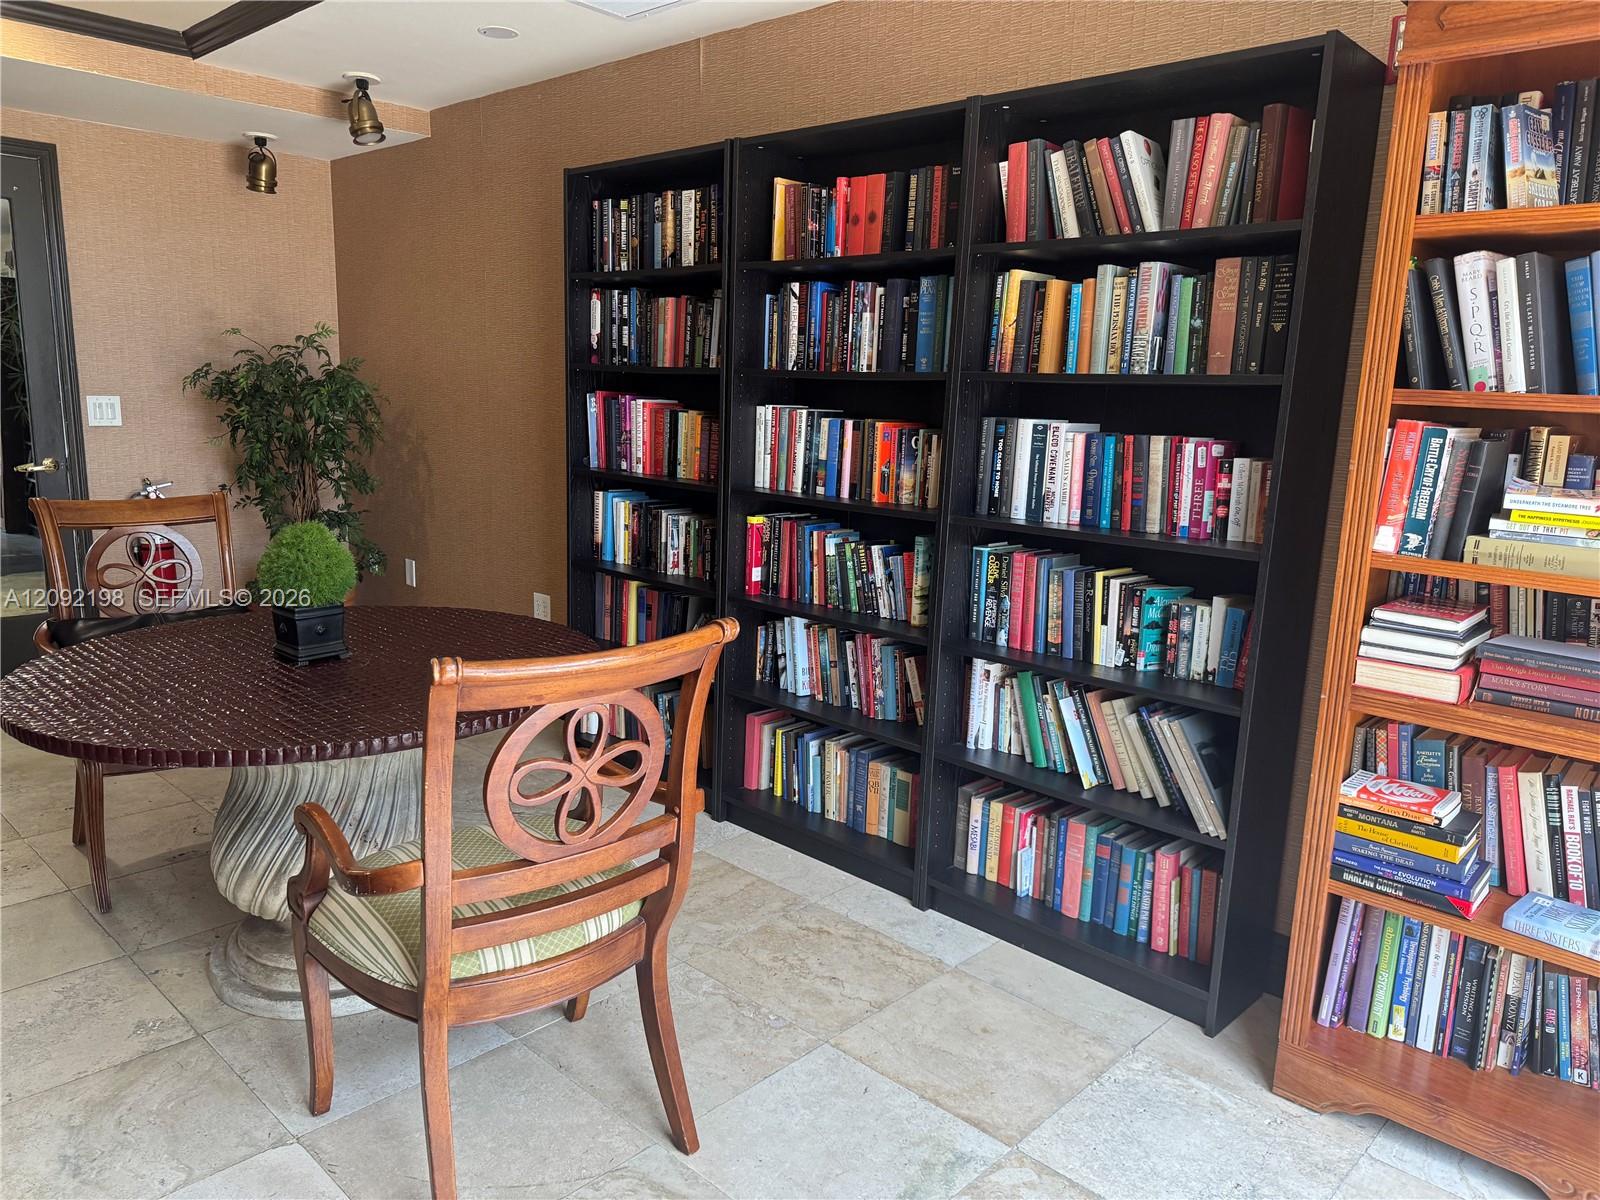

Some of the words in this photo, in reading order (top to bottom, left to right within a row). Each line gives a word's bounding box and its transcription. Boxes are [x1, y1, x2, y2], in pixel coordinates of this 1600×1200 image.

[1455, 112, 1465, 133] CLIVE
[1452, 134, 1464, 169] CUSSLER'S
[1472, 138, 1483, 163] CORNWELL
[1526, 131, 1554, 153] CUSSLER
[1192, 151, 1202, 170] ALSO
[1574, 145, 1583, 166] AWAY
[1190, 172, 1199, 186] SETS
[1452, 187, 1460, 204] DEVIL'S
[1260, 260, 1269, 276] Pink
[1140, 266, 1153, 296] PATRICIA
[1258, 276, 1267, 292] Slip
[1128, 294, 1136, 307] OUR
[1433, 294, 1443, 308] Men
[790, 301, 799, 332] TRIPLE
[1126, 308, 1134, 333] HEALTH
[1136, 297, 1150, 329] CORNWELL
[1110, 311, 1119, 341] PERSIAN
[1436, 313, 1449, 335] Women
[1109, 342, 1118, 356] BOY
[1123, 333, 1131, 360] MATTERS
[1131, 333, 1149, 362] TRACE
[1427, 437, 1443, 463] BATTLE
[995, 471, 1001, 480] TO
[1048, 449, 1058, 484] COVENANT
[1424, 463, 1438, 477] CRY
[1423, 477, 1434, 487] OF
[1192, 479, 1204, 520] THREE
[1415, 487, 1433, 520] FREEDOM
[1505, 522, 1516, 530] GET
[1559, 527, 1569, 535] PIT
[1552, 516, 1580, 524] HYPOTHESIS
[987, 555, 995, 584] CUSSLER
[1001, 556, 1009, 579] Daniel
[1000, 580, 1008, 598] Silva
[984, 599, 993, 628] REVENGE
[1505, 664, 1527, 675] Weigh
[1528, 668, 1549, 678] Down
[1551, 673, 1566, 681] Diet
[1536, 660, 1557, 668] LEOPARD
[1491, 676, 1520, 687] MARK'S
[1521, 681, 1550, 692] STORY
[868, 780, 880, 788] QB
[1546, 787, 1560, 809] GEMINI
[1566, 788, 1575, 813] RACHAEL
[1582, 800, 1590, 815] EIGHT
[1343, 807, 1359, 815] NORTH
[1358, 813, 1398, 828] MONTANA
[1400, 811, 1421, 821] DIARY
[1357, 824, 1369, 832] The
[1369, 827, 1389, 837] House
[1568, 814, 1576, 830] RAY'S
[1584, 816, 1592, 834] WORDS
[969, 824, 978, 850] MESABI
[1565, 834, 1581, 860] BOOK
[1351, 846, 1378, 857] WAKING
[1396, 857, 1415, 867] DEAD
[1567, 860, 1582, 876] OF
[1133, 879, 1139, 889] AT
[1342, 872, 1374, 889] HARLAN
[1394, 875, 1431, 889] DISCOVERIES
[1397, 871, 1437, 887] EVOLUTION
[1568, 878, 1583, 890] 10
[1129, 889, 1138, 920] WILDINGS
[1420, 934, 1428, 945] AND
[1513, 919, 1540, 939] THREE
[1543, 929, 1580, 952] SISTERS
[1376, 926, 1394, 971] abnormal
[1405, 940, 1418, 975] Developmental
[1415, 957, 1425, 979] ENGLISH
[1372, 970, 1388, 1017] PSYCHOLOGY
[1399, 976, 1413, 1002] Psychology
[1468, 979, 1478, 1011] WRITING
[1511, 972, 1524, 997] DEAN
[1575, 979, 1583, 1009] STEPHEN
[1461, 981, 1471, 1016] REVISION
[1495, 992, 1503, 1014] CATAPULT
[1466, 1013, 1473, 1023] AS
[1506, 995, 1521, 1031] KOONTZ
[1545, 1008, 1555, 1025] FAKE
[1516, 1019, 1524, 1046] WORKBOOK
[1545, 1025, 1555, 1034] ID
[1577, 1071, 1584, 1080] K
